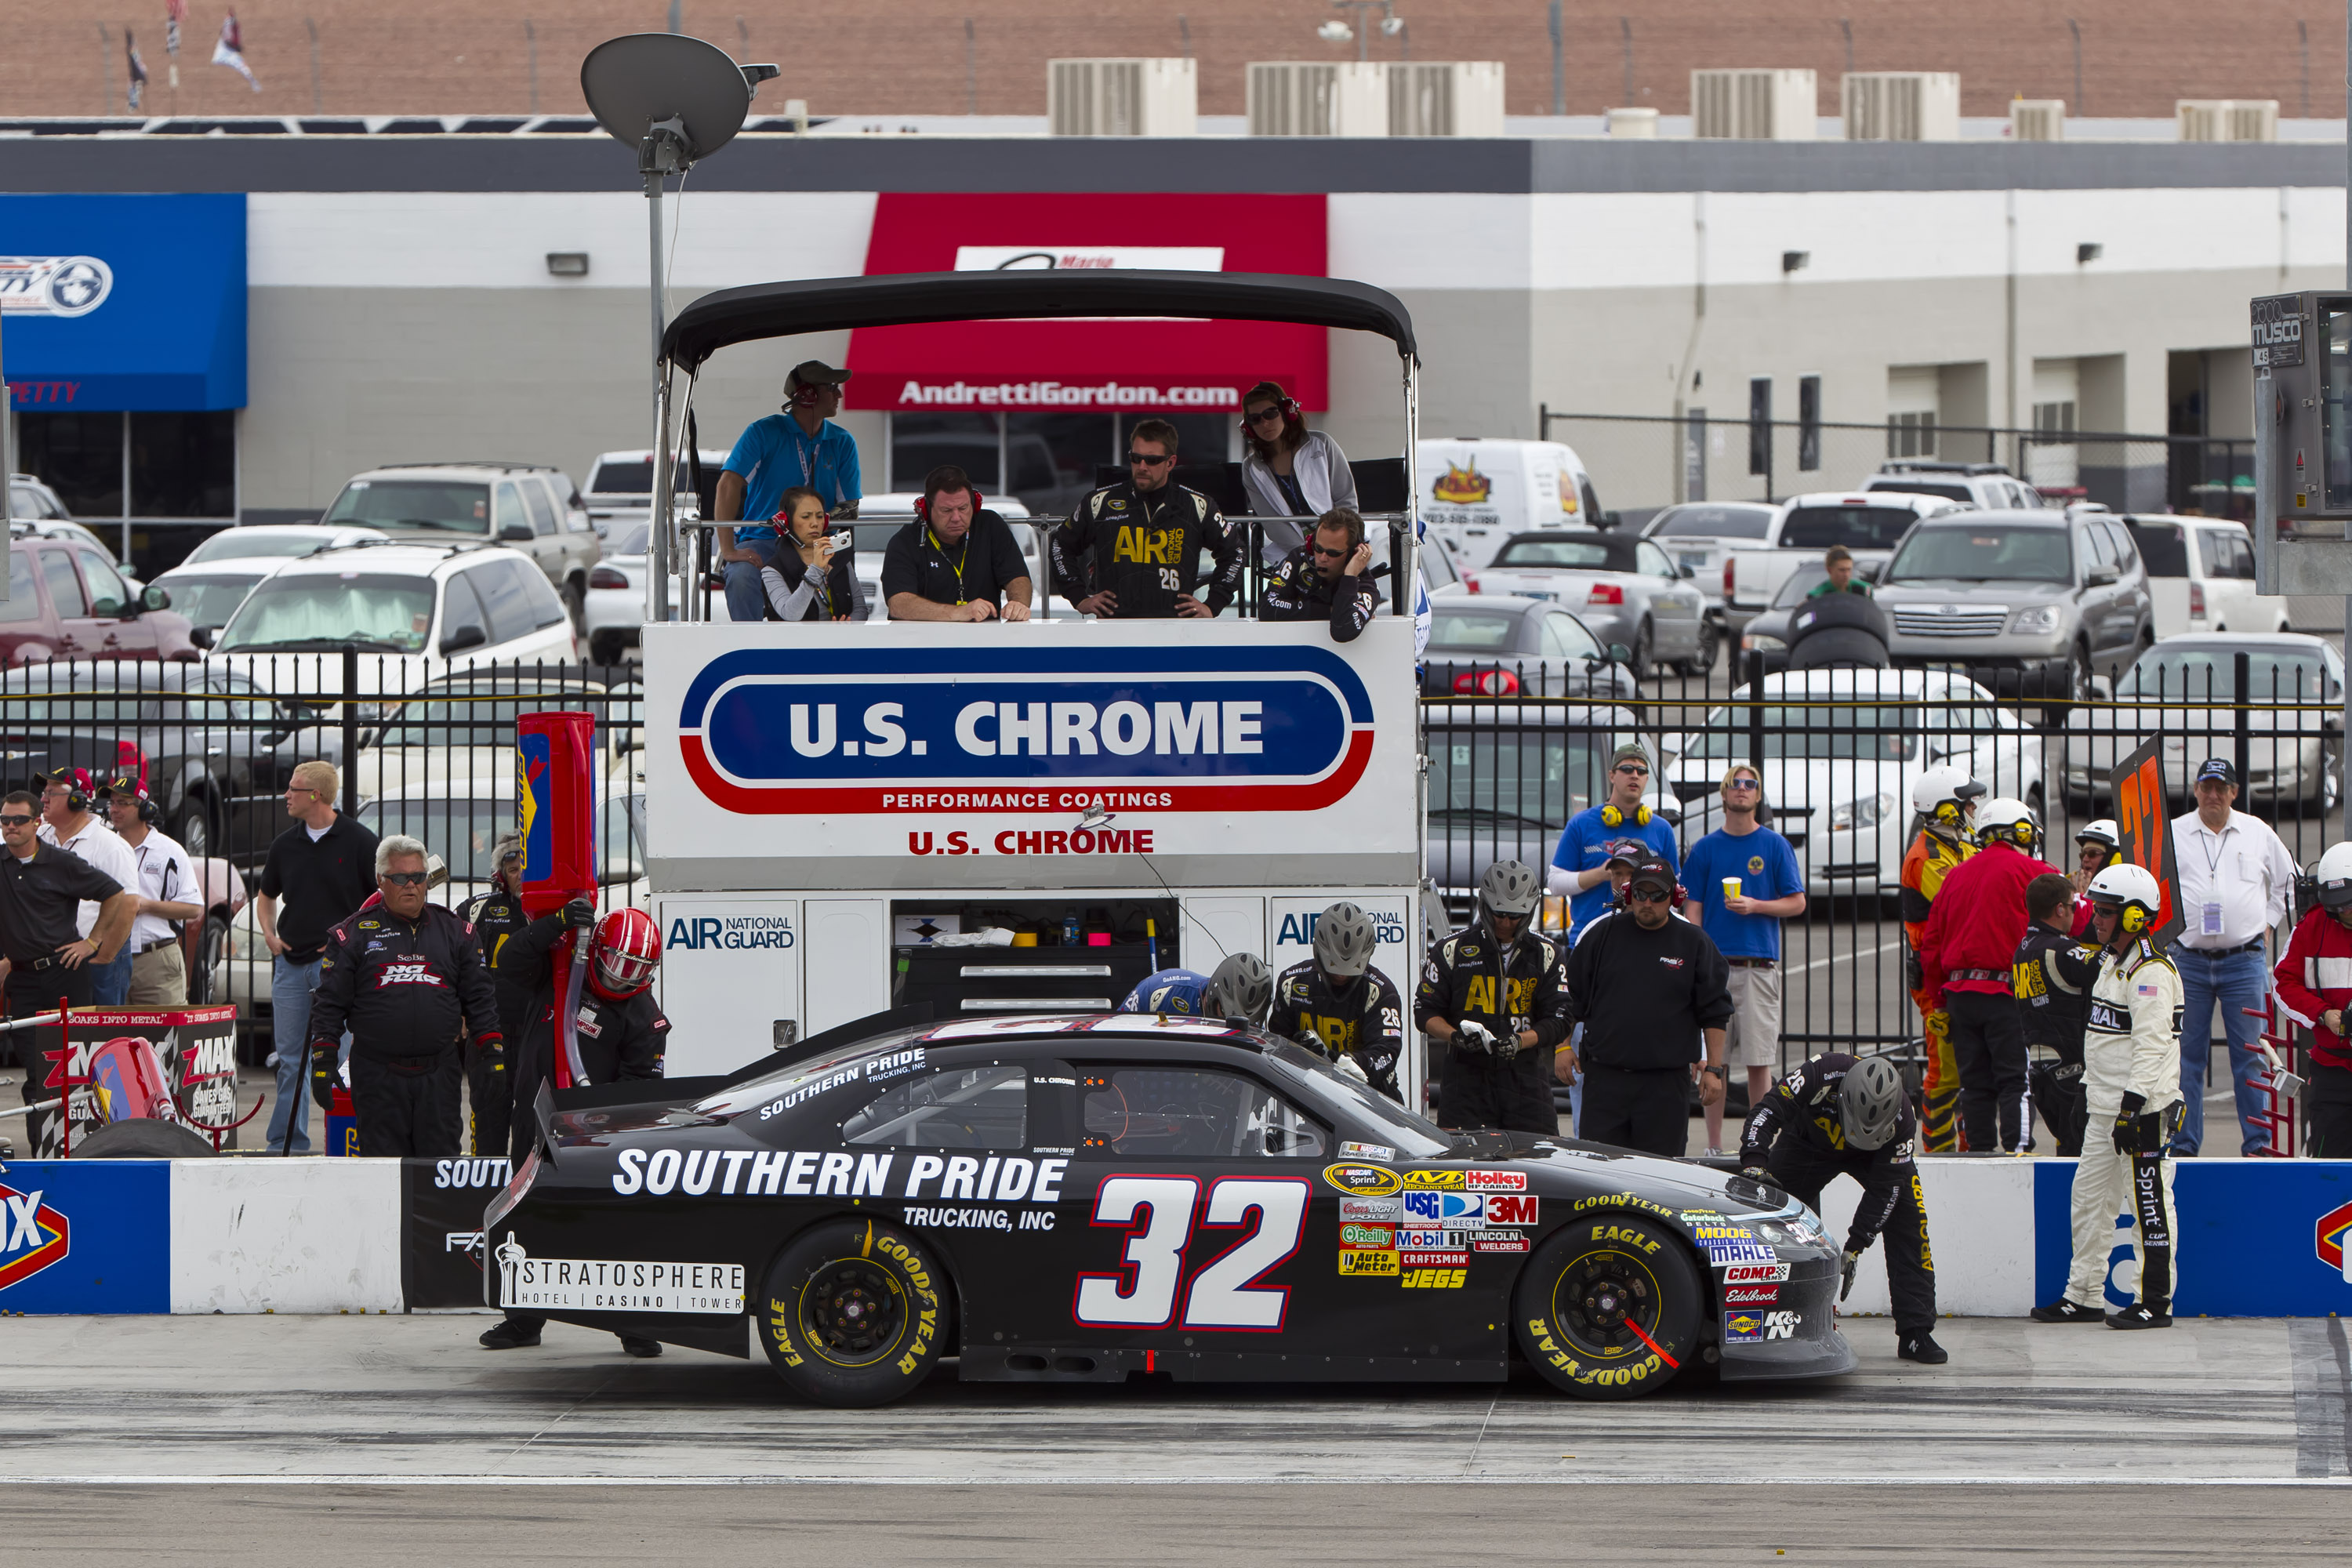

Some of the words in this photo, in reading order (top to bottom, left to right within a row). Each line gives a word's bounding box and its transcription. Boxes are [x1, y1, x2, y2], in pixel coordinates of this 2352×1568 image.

[2252, 320, 2301, 345] MUSCO
[2259, 350, 2268, 362] 45
[7, 381, 82, 403] PETTY
[898, 381, 1239, 405] AndrettiGordon.com
[1113, 525, 1168, 564] AIR
[1167, 528, 1176, 564] NATIONAL
[1174, 528, 1185, 564] GUARD
[1159, 568, 1180, 591] 26
[790, 702, 927, 757] U.S.
[955, 700, 1263, 757] CHROME
[883, 793, 1050, 808] PERFORMANCE
[1058, 792, 1172, 808] COATINGS
[909, 831, 979, 855] U.S.
[994, 829, 1153, 854] CHROME
[666, 917, 723, 950] AIR
[726, 916, 793, 930] NATIONAL
[724, 931, 794, 949] GUARD
[615, 949, 652, 964] Budweiser
[2013, 962, 2035, 1000] AIR
[2034, 959, 2047, 994] GUARD
[1465, 975, 1522, 1014] AIR
[2031, 994, 2049, 1007] RACING
[103, 1015, 128, 1024] INTO
[1381, 1007, 1401, 1028] 26
[1300, 1011, 1347, 1052] AIR
[868, 1065, 910, 1083] TRUCKING,
[912, 1062, 927, 1072] INC
[1048, 1077, 1076, 1086] CHROME
[1786, 1069, 1806, 1094] 26
[760, 1067, 859, 1121] SOUTHERN
[866, 1047, 925, 1076] PRIDE
[194, 1089, 217, 1105] SAVES
[218, 1087, 232, 1103] GAS
[1359, 1145, 1387, 1156] NASCAR
[1896, 1138, 1913, 1156] 26
[612, 1149, 892, 1196] SOUTHERN
[904, 1153, 1068, 1202] PRIDE
[1350, 1176, 1376, 1185] Sprint
[1468, 1172, 1524, 1189] Holley
[1405, 1192, 1439, 1220] USG
[1574, 1192, 1673, 1218] GOODYEAR
[2136, 1166, 2161, 1226] Sprint
[1343, 1202, 1369, 1214] Coors
[1487, 1196, 1537, 1223] 3M
[1679, 1213, 1726, 1223] Gatorback
[903, 1207, 1012, 1232] TRUCKING,
[1018, 1210, 1056, 1231] INC
[1343, 1225, 1392, 1243] O'Reilly
[1396, 1231, 1444, 1246] Mobil
[1453, 1232, 1459, 1245] 1
[1469, 1232, 1519, 1241] LINCOLN
[1592, 1225, 1661, 1254] EAGLE
[1696, 1227, 1752, 1240] MOOG
[1785, 1222, 1817, 1244] 32
[1072, 1173, 1313, 1333] 32
[1356, 1253, 1388, 1262] Auto
[1403, 1254, 1467, 1264] CRAFTSMAN
[1711, 1246, 1775, 1262] MAHLE
[523, 1261, 742, 1290] STRATOSPHERE
[1354, 1261, 1396, 1272] Meter
[1728, 1266, 1776, 1280] COMP
[1401, 1269, 1468, 1288] JEGS
[522, 1293, 569, 1305] HOTEL
[596, 1294, 664, 1308] CASINO
[691, 1298, 742, 1310] TOWER
[877, 1236, 938, 1375] GOODYEAR
[1726, 1289, 1778, 1303] Edelbrock
[771, 1298, 804, 1367] EAGLE
[1729, 1320, 1761, 1329] SUNOCO
[1529, 1318, 1661, 1385] GOODYEAR
